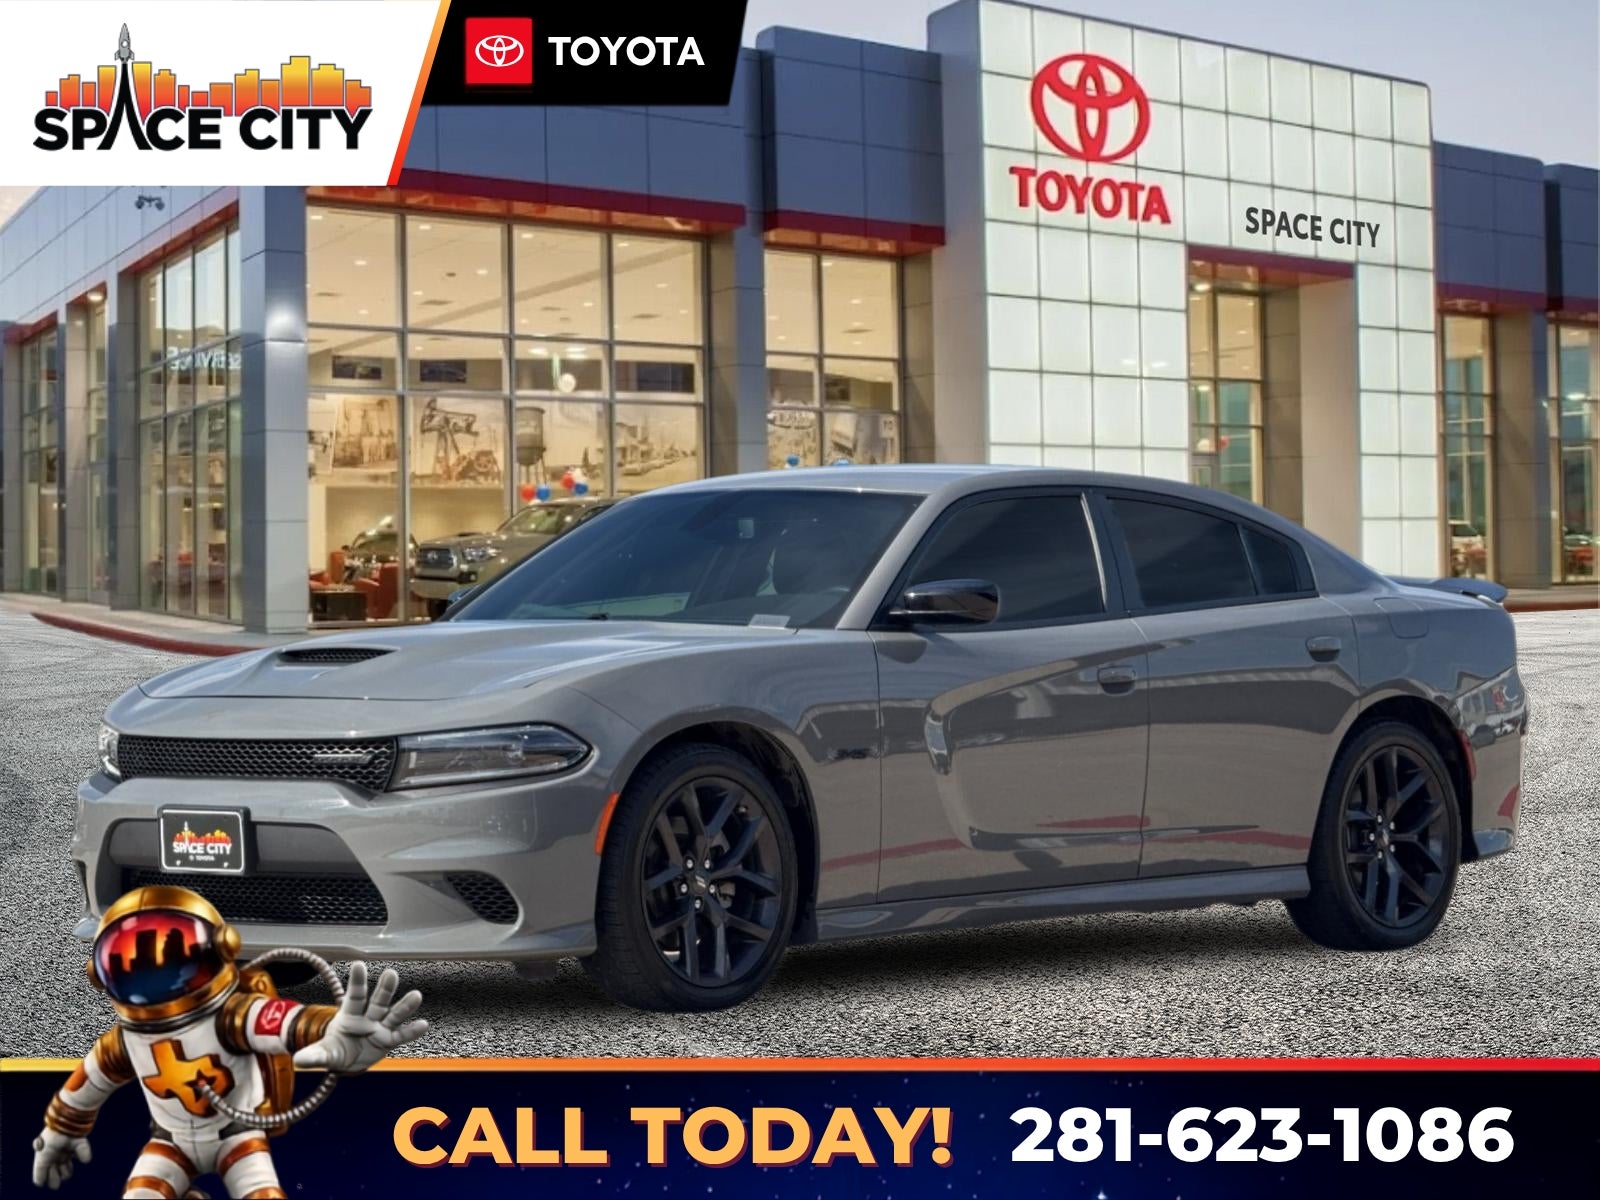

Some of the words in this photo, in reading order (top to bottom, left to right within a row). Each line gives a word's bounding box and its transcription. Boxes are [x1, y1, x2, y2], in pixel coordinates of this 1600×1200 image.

[1008, 165, 1172, 224] TOYOTA
[1245, 206, 1323, 242] SPACE
[1329, 217, 1381, 249] CITY
[172, 841, 205, 854] SPACE
[206, 842, 232, 855] CITY
